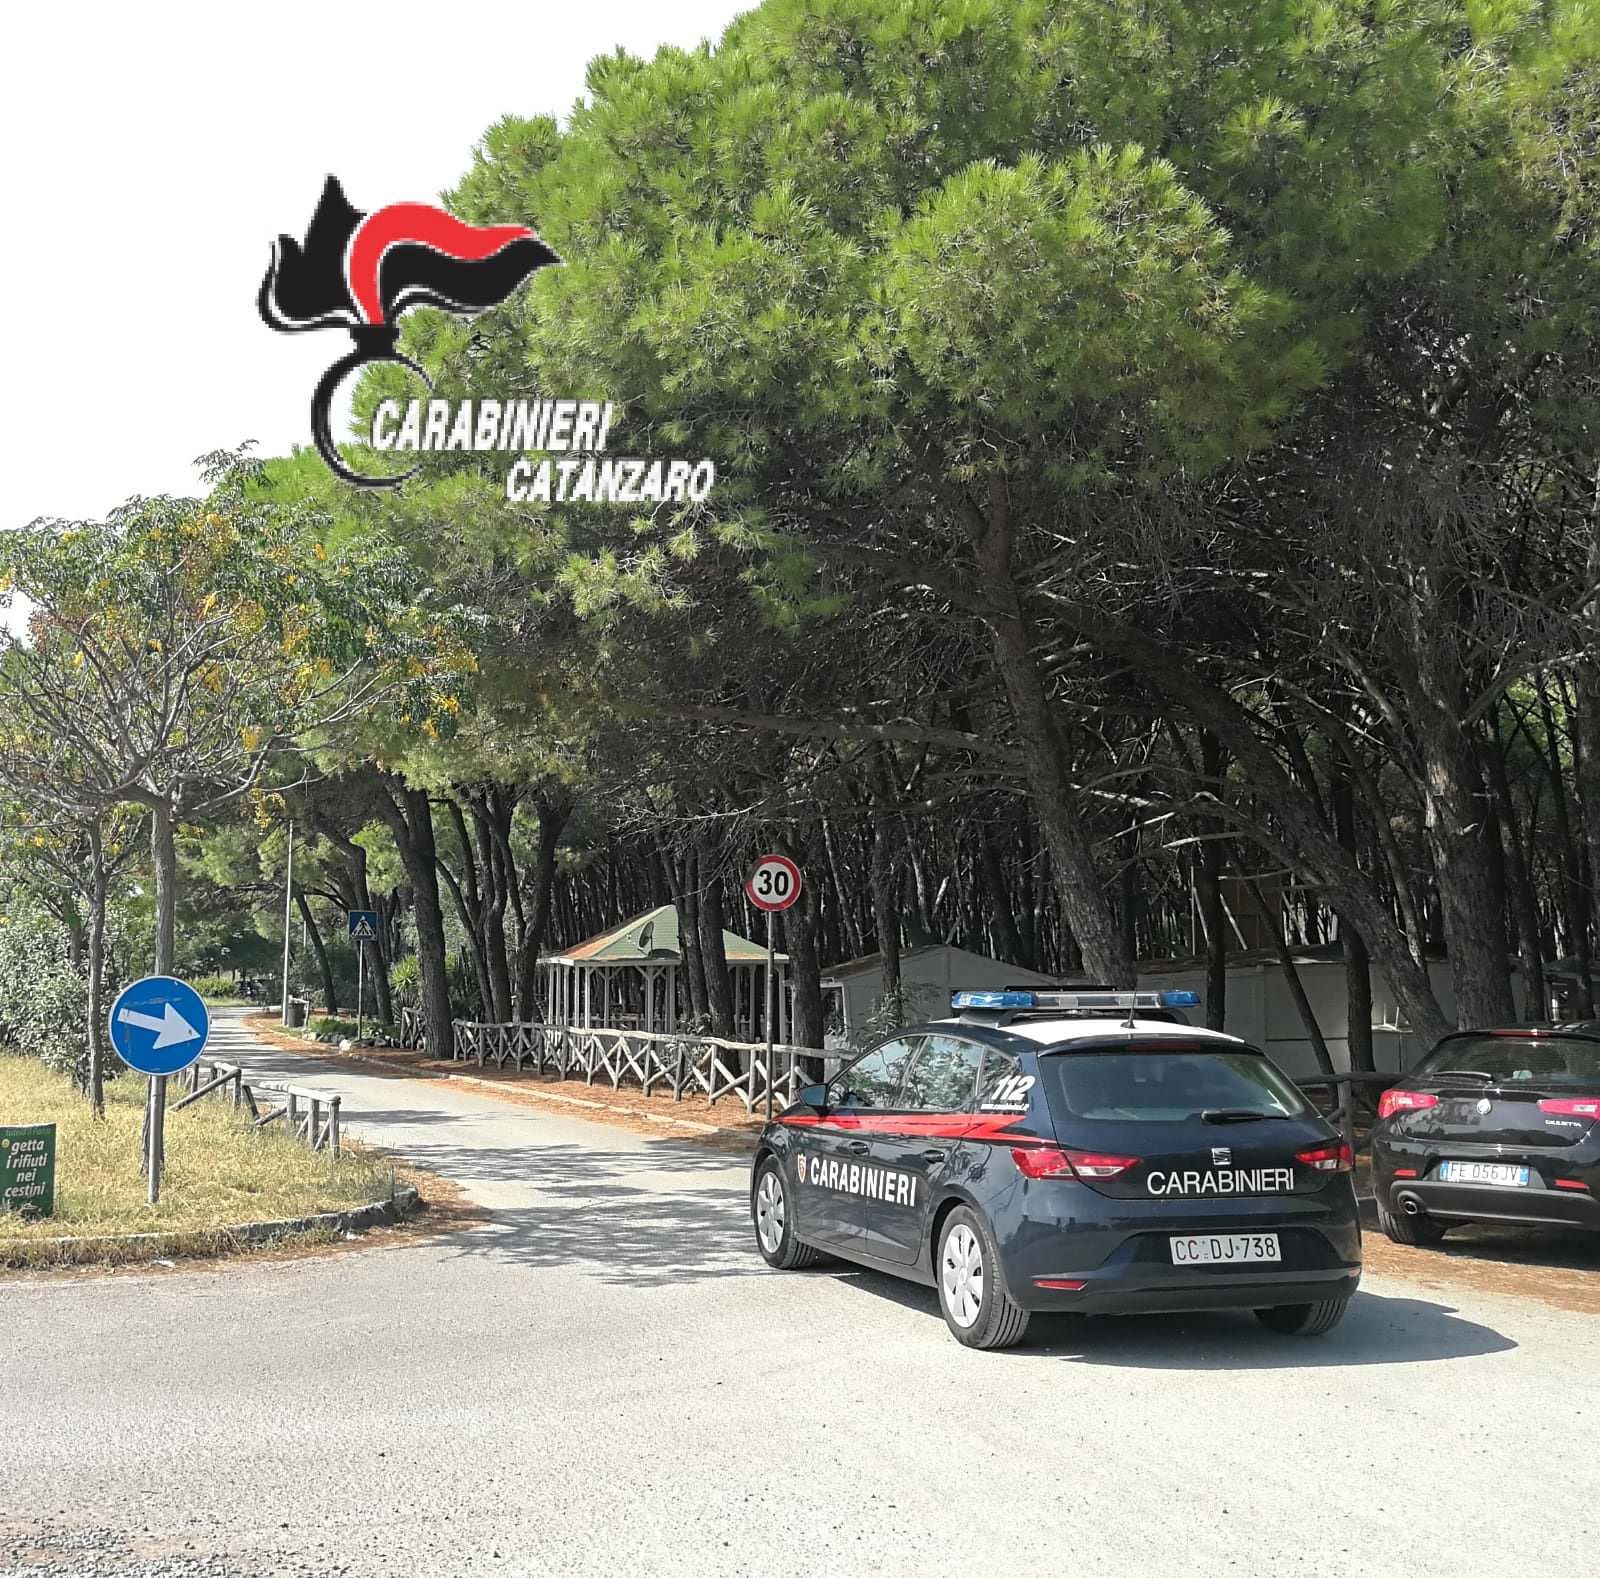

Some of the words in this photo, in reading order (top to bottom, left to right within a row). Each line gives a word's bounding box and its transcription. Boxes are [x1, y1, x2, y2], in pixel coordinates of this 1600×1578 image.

[758, 869, 789, 896] 30
[991, 1074, 1036, 1101] 112
[11, 1139, 45, 1155] getta
[6, 1155, 12, 1169] i
[12, 1153, 48, 1169] rifiuti
[16, 1168, 37, 1183] nei
[810, 1157, 917, 1207] CARABINIERI
[1147, 1168, 1294, 1195] CARABINIERI
[5, 1182, 46, 1198] cestini
[1175, 1240, 1200, 1261] CC
[1210, 1237, 1234, 1260] DJ
[1240, 1237, 1277, 1259] 738
